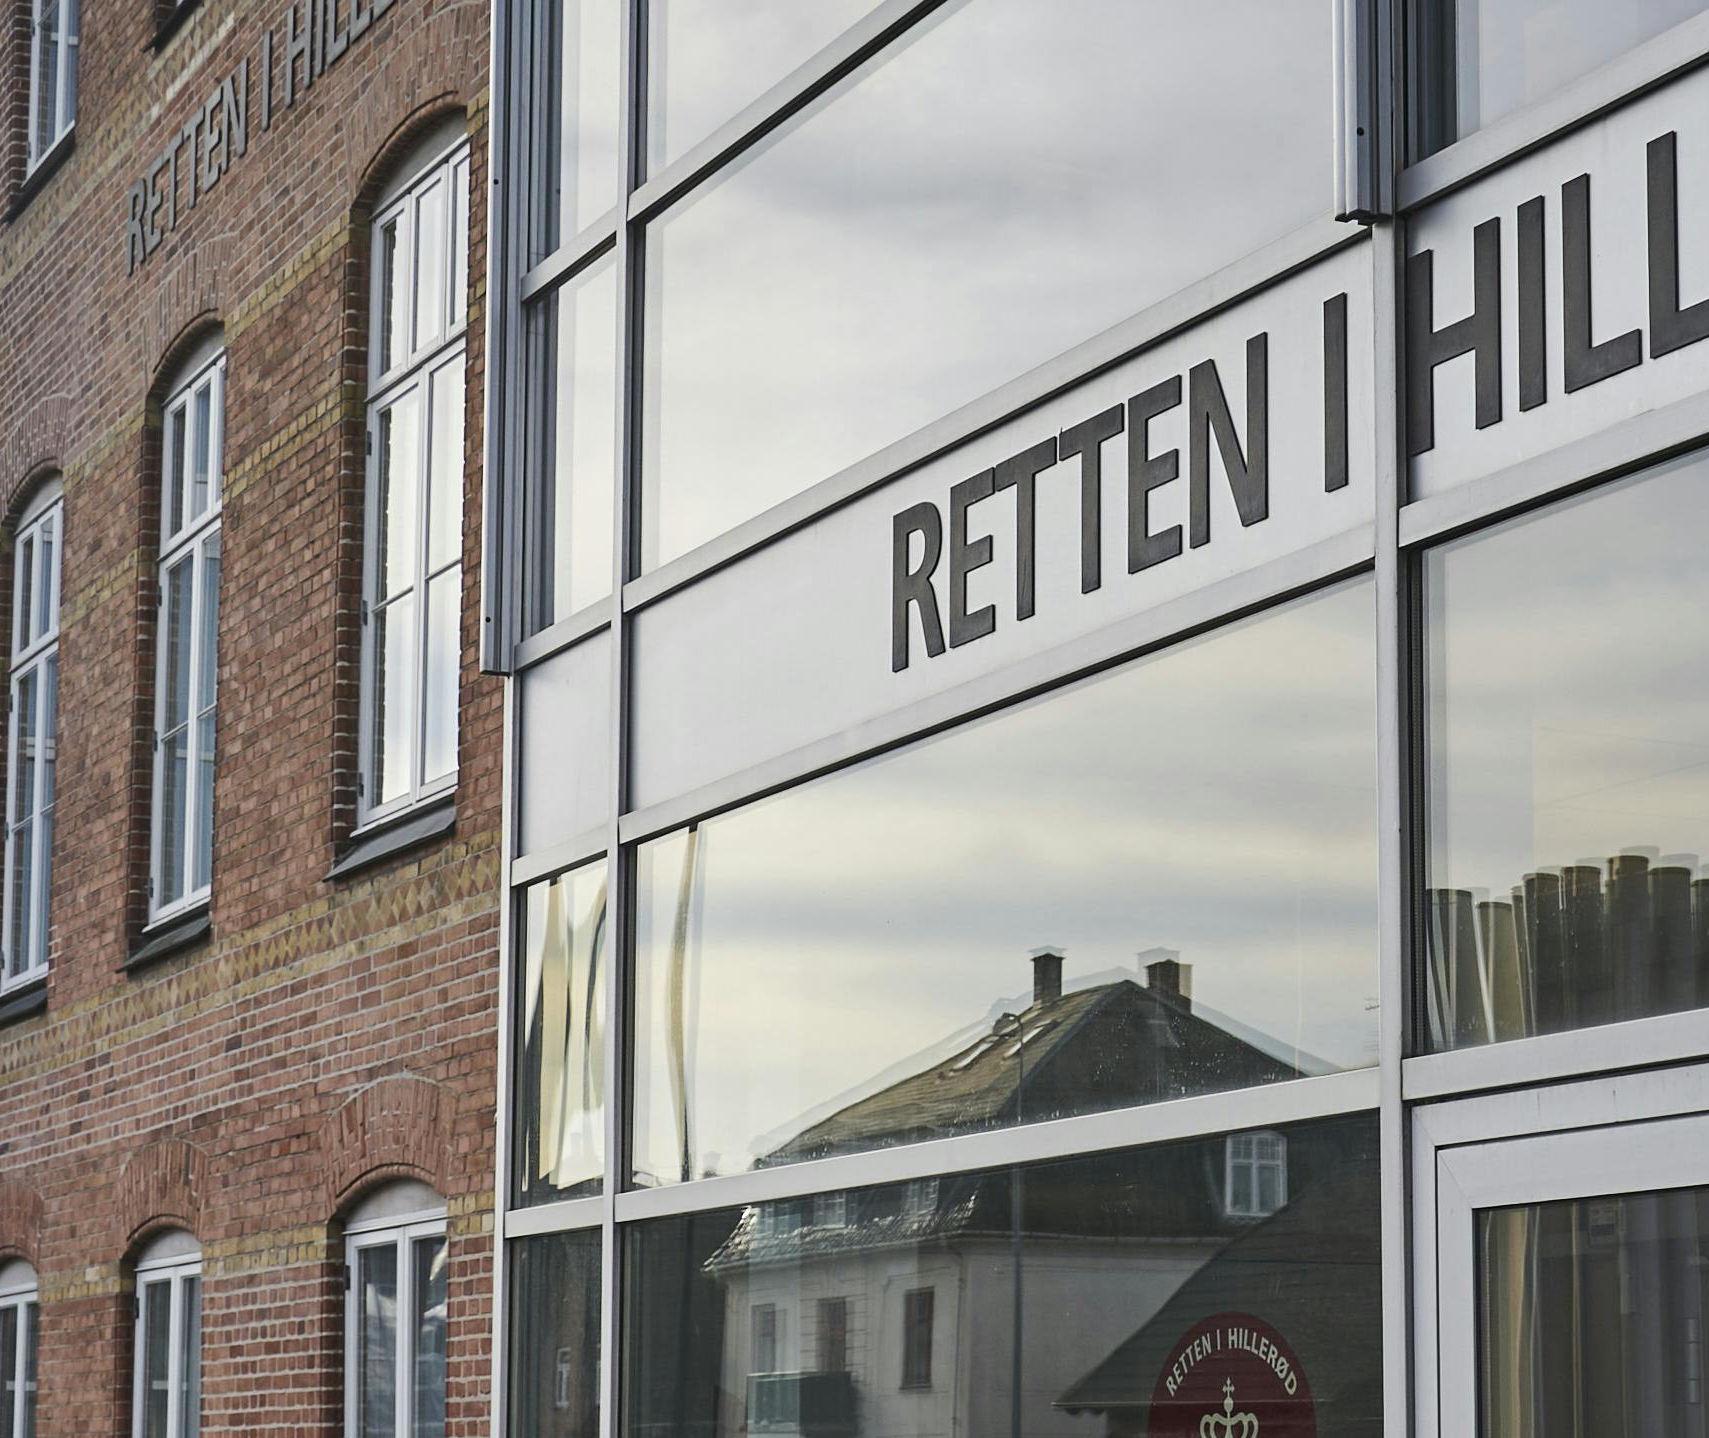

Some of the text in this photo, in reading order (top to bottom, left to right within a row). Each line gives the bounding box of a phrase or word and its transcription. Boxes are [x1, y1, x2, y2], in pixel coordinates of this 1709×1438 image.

[126, 57, 249, 276] RETTEN
[261, 29, 273, 131] I
[891, 331, 1269, 672] RETTEN
[1323, 291, 1349, 493] I
[1166, 1328, 1297, 1397] RETTEN I HILLERØD
